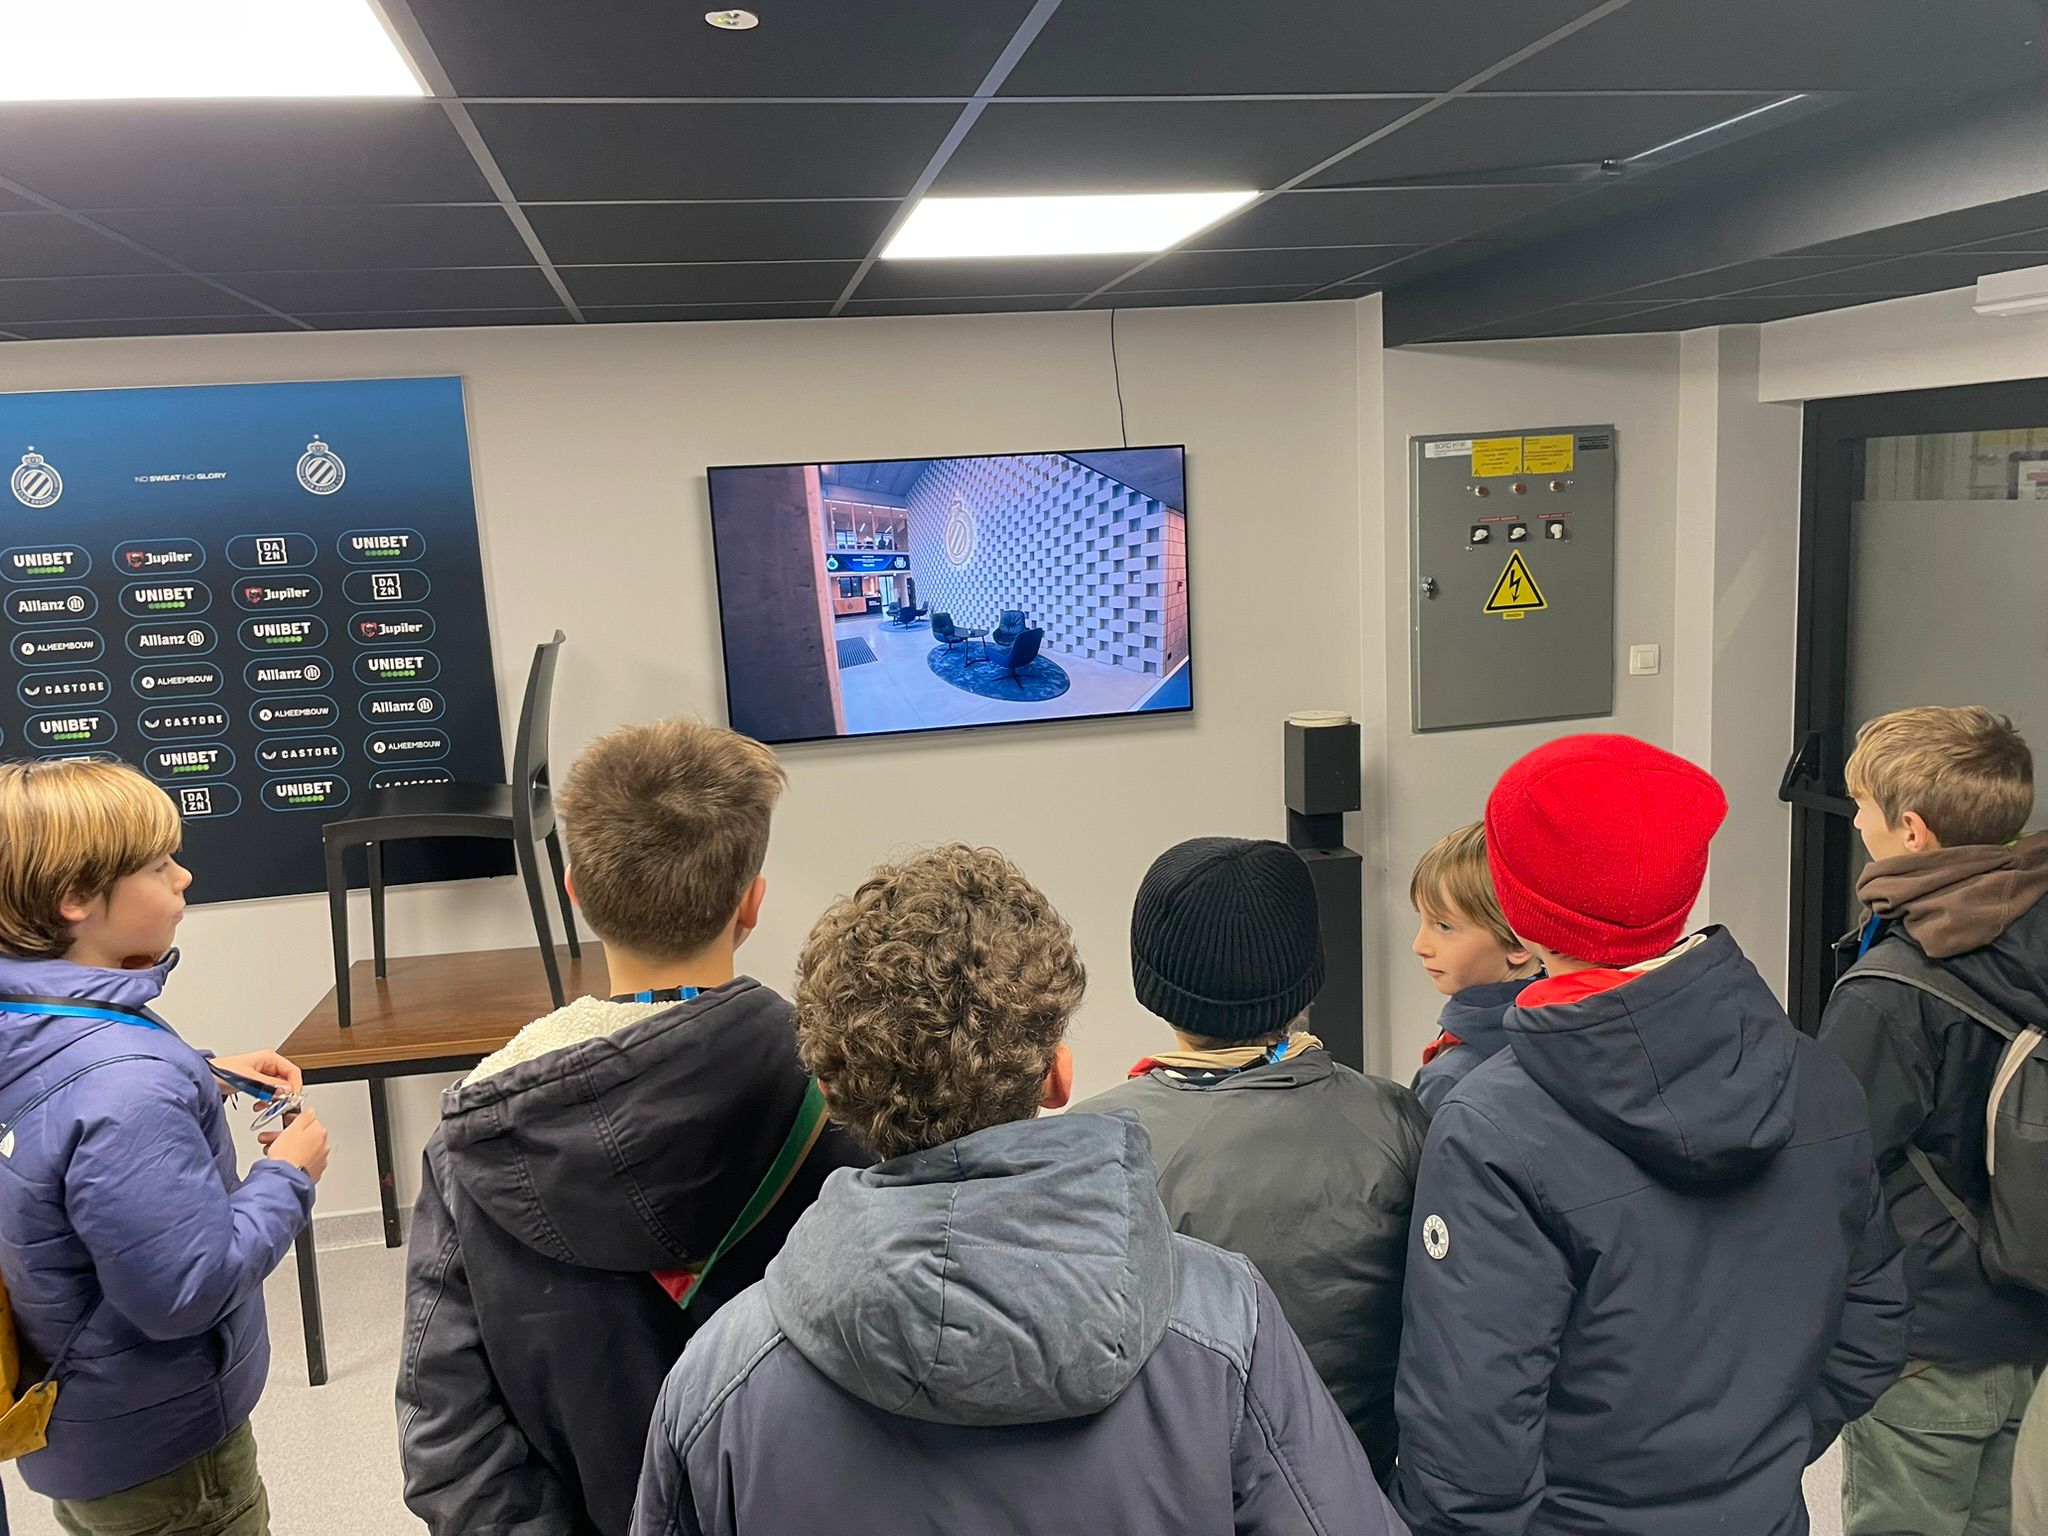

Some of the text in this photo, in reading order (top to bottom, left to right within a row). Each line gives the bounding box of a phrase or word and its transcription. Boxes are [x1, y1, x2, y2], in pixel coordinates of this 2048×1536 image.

[149, 474, 180, 482] SWEAT
[197, 472, 227, 480] GLORY
[352, 535, 409, 550] UNIBET
[13, 552, 73, 567] UNIBET
[144, 551, 192, 565] Jupiler
[135, 587, 194, 602] UNIBET
[264, 587, 310, 601] Jupiler
[19, 599, 65, 612] Allianz
[253, 622, 311, 637] UNIBET
[378, 622, 424, 635] Jupiler
[37, 641, 94, 653] ALHEEMBOUW
[140, 633, 185, 647] Allianz
[368, 656, 425, 671] UNIBET
[157, 674, 214, 686] ALHEEMBOUW
[257, 667, 303, 681] Allianz
[45, 681, 104, 695] CASTORE
[274, 707, 329, 718] ALHEEMBOUW
[372, 701, 415, 714] Allianz
[40, 717, 99, 733] UNIBET
[165, 714, 223, 727] CASTORE
[388, 739, 441, 750] ALHEEMBOUW
[160, 750, 218, 766] UNIBET
[281, 746, 338, 759] CASTORE
[276, 781, 333, 797] UNIBET
